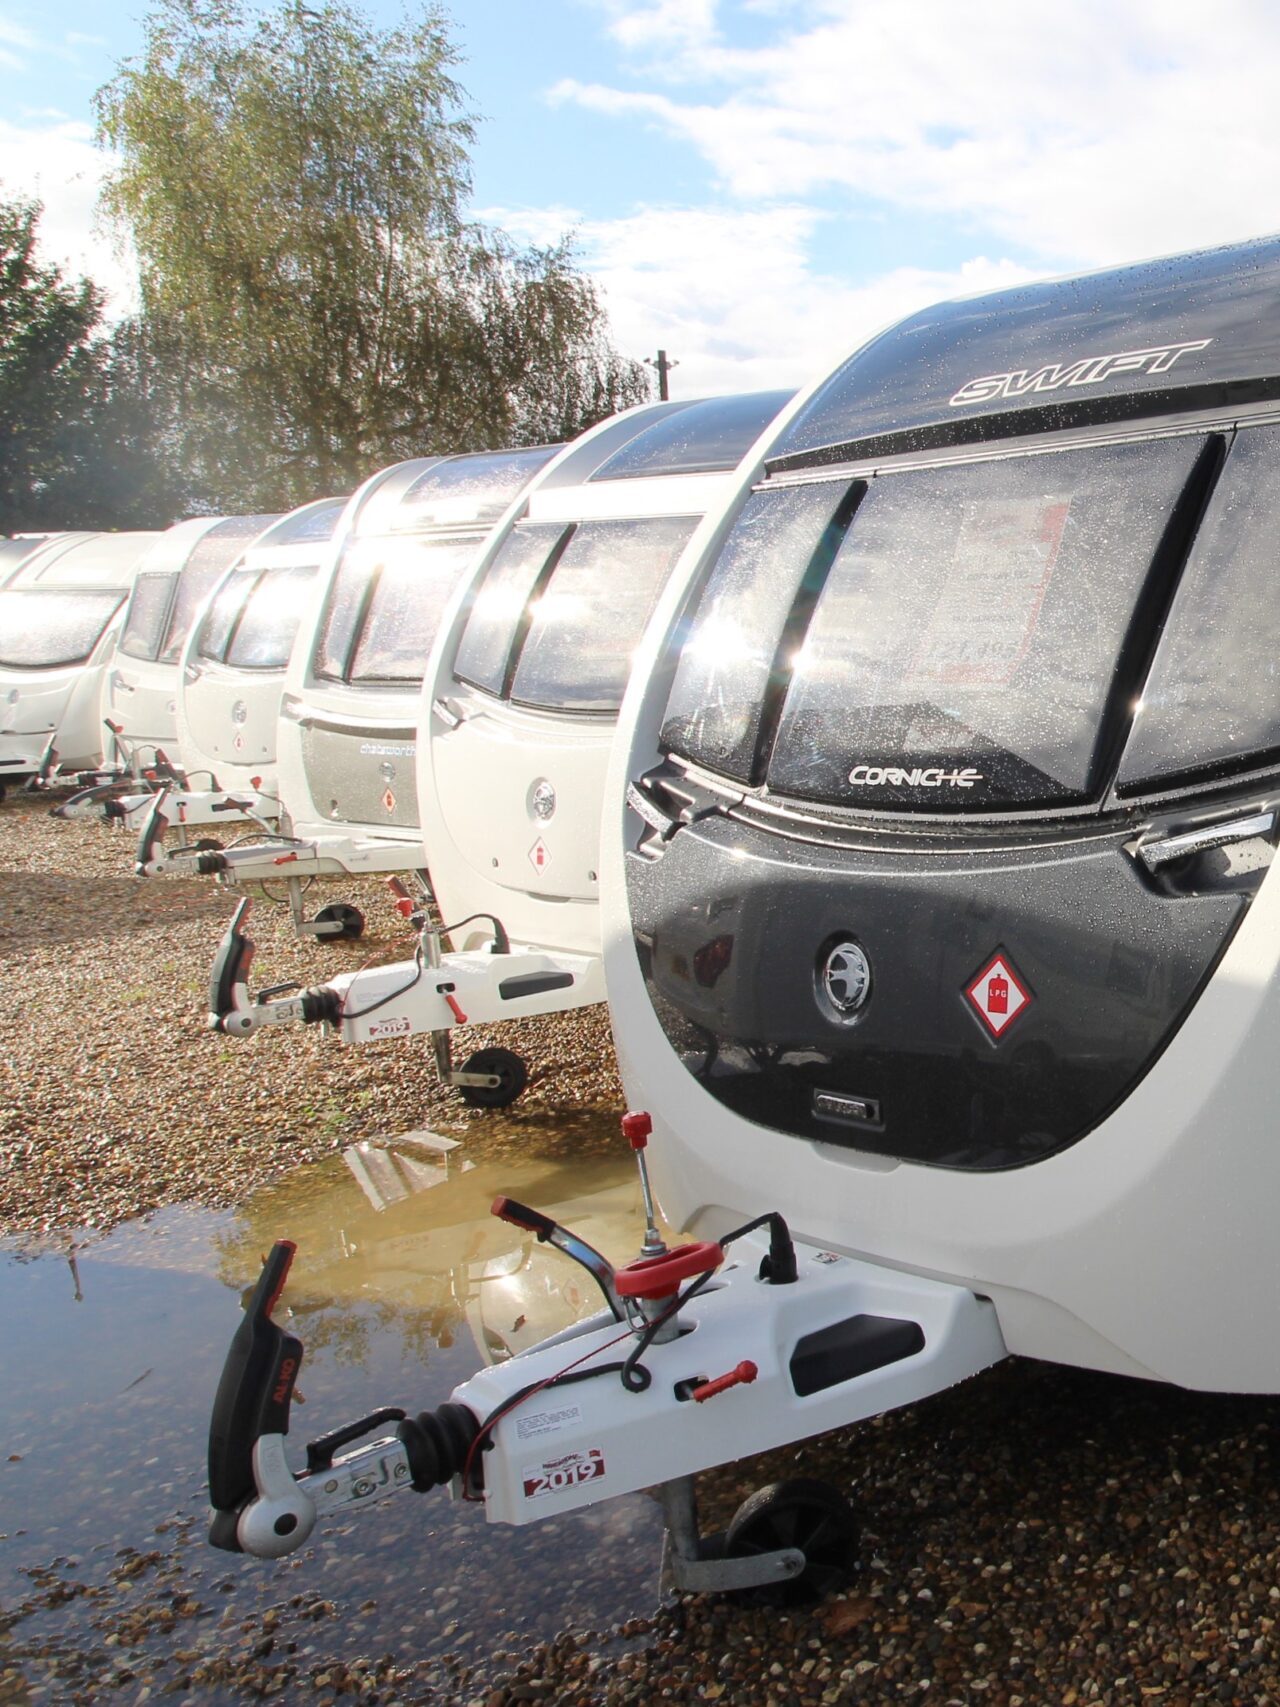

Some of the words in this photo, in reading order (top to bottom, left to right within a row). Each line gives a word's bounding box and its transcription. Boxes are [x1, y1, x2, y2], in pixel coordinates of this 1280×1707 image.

[949, 338, 1214, 406] SWIFT
[849, 765, 983, 787] CORNICHE
[989, 988, 1007, 998] LPG
[533, 1460, 597, 1496] 2019
